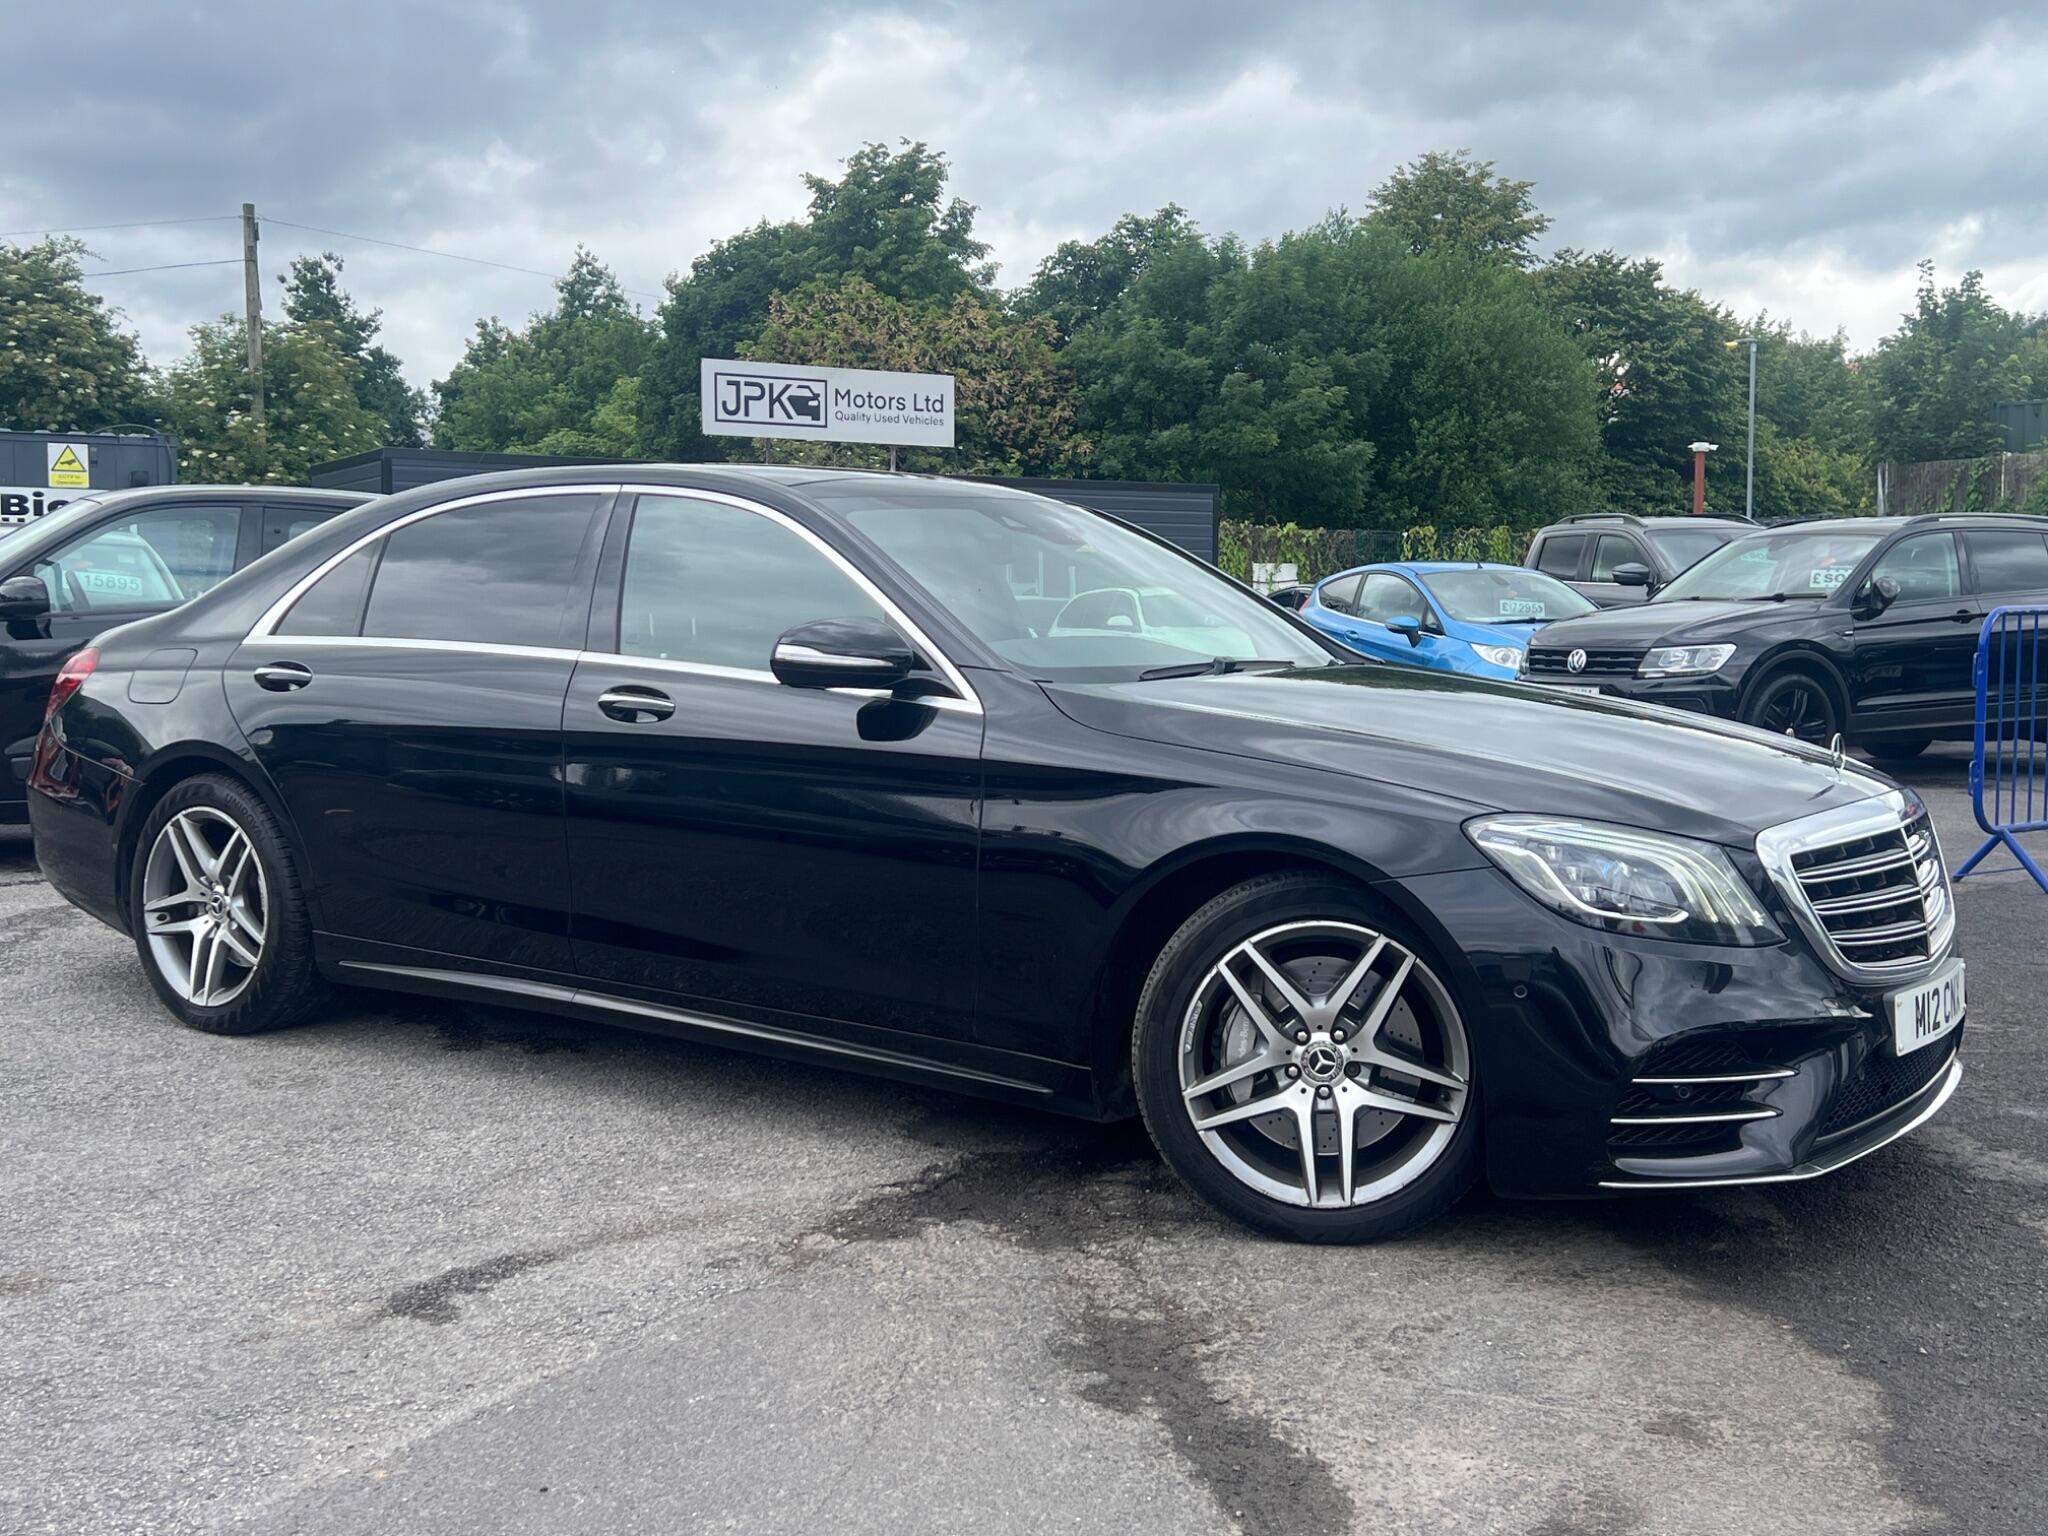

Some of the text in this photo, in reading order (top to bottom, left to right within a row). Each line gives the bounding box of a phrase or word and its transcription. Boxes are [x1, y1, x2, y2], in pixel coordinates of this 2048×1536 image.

[722, 380, 793, 420] JPK
[835, 388, 944, 413] Motors Ltd
[835, 410, 944, 426] Quality Used Vehicles
[84, 575, 140, 591] 15895
[1915, 988, 1941, 1039] M12
